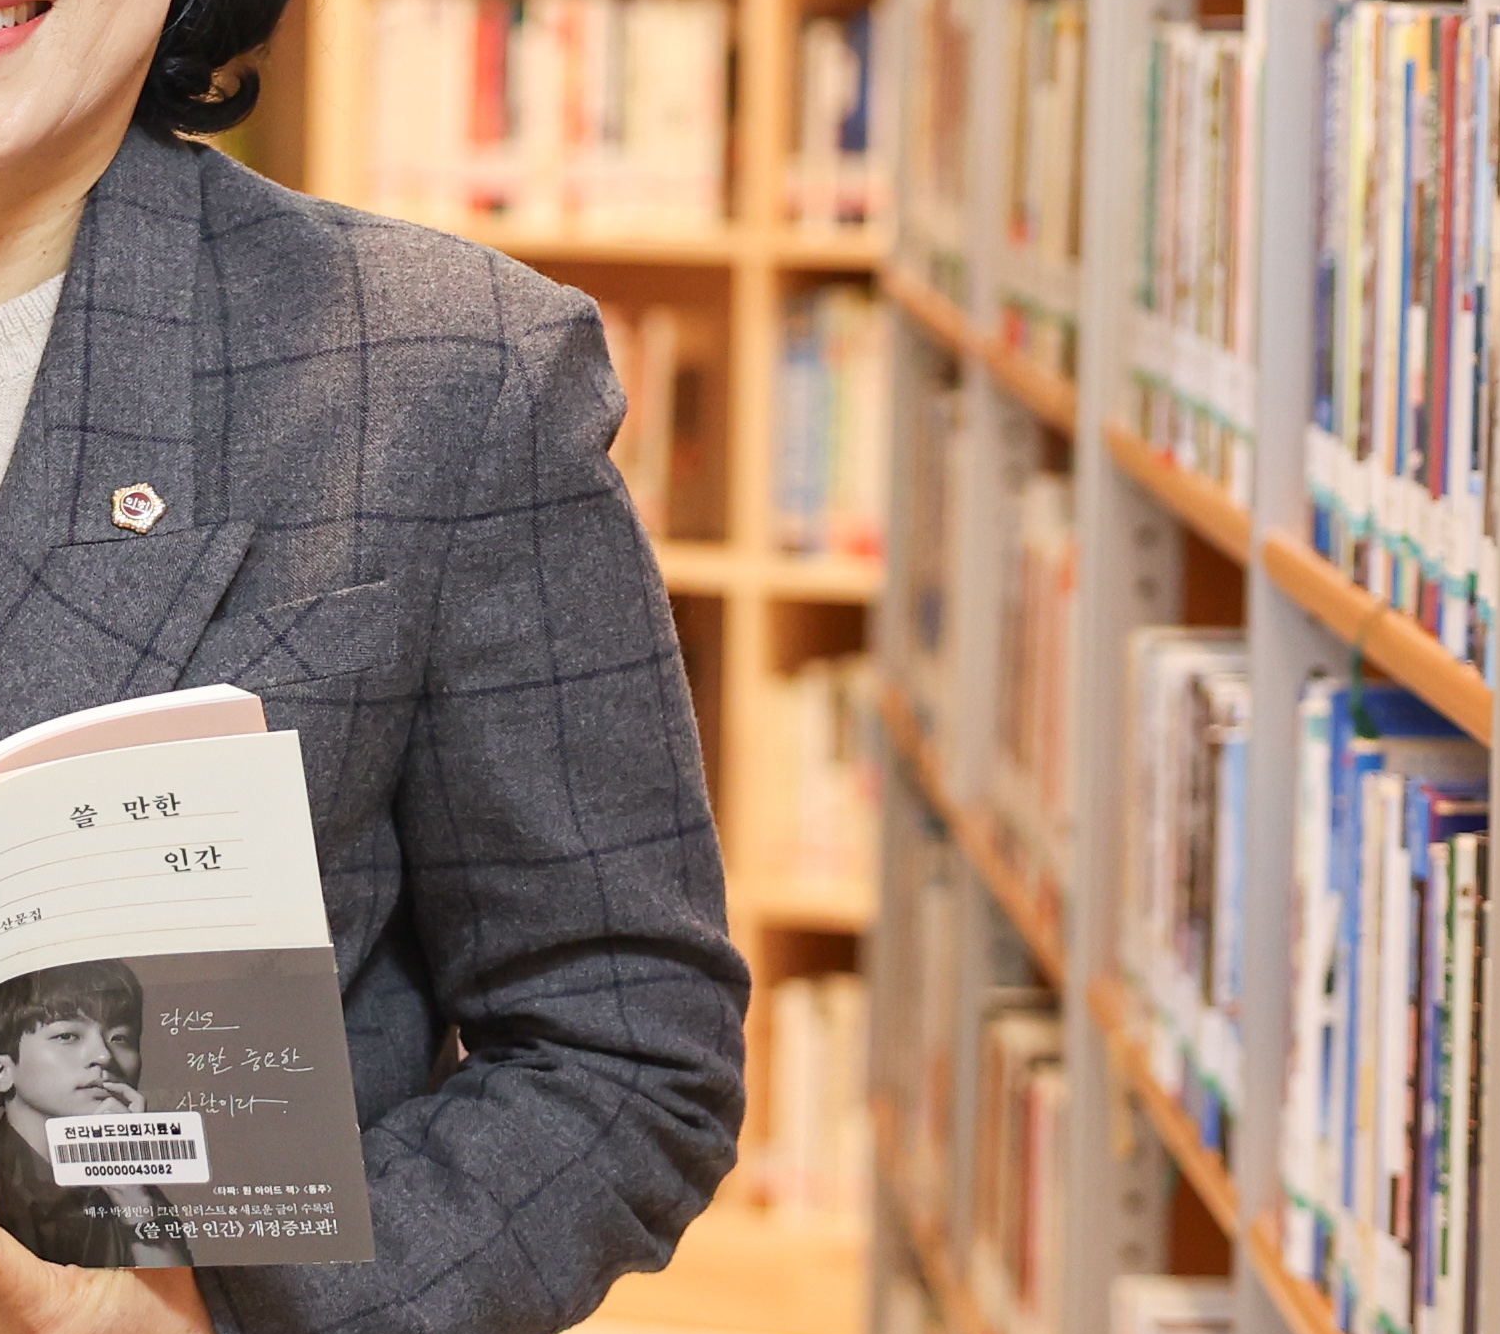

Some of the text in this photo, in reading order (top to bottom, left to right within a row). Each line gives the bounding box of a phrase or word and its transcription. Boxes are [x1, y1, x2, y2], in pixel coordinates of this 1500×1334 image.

[123, 495, 150, 512] 의회
[69, 792, 181, 829] 쓸 만한
[164, 846, 222, 873] 인간
[0, 908, 43, 931] 산문집
[187, 1047, 314, 1075] 정말 중요한
[64, 1122, 181, 1140] 전라남도의회자료실
[85, 1164, 172, 1176] 000000043082
[110, 1205, 153, 1217] 박정민이
[157, 1205, 179, 1216] 그린
[182, 1204, 226, 1216] 일러스트
[229, 1205, 237, 1216] &
[240, 1204, 272, 1216] 새로운
[275, 1203, 298, 1215] 글이
[301, 1202, 335, 1215] 수록된
[165, 1221, 198, 1238] 만한
[249, 1219, 338, 1237] 개정증보판!
